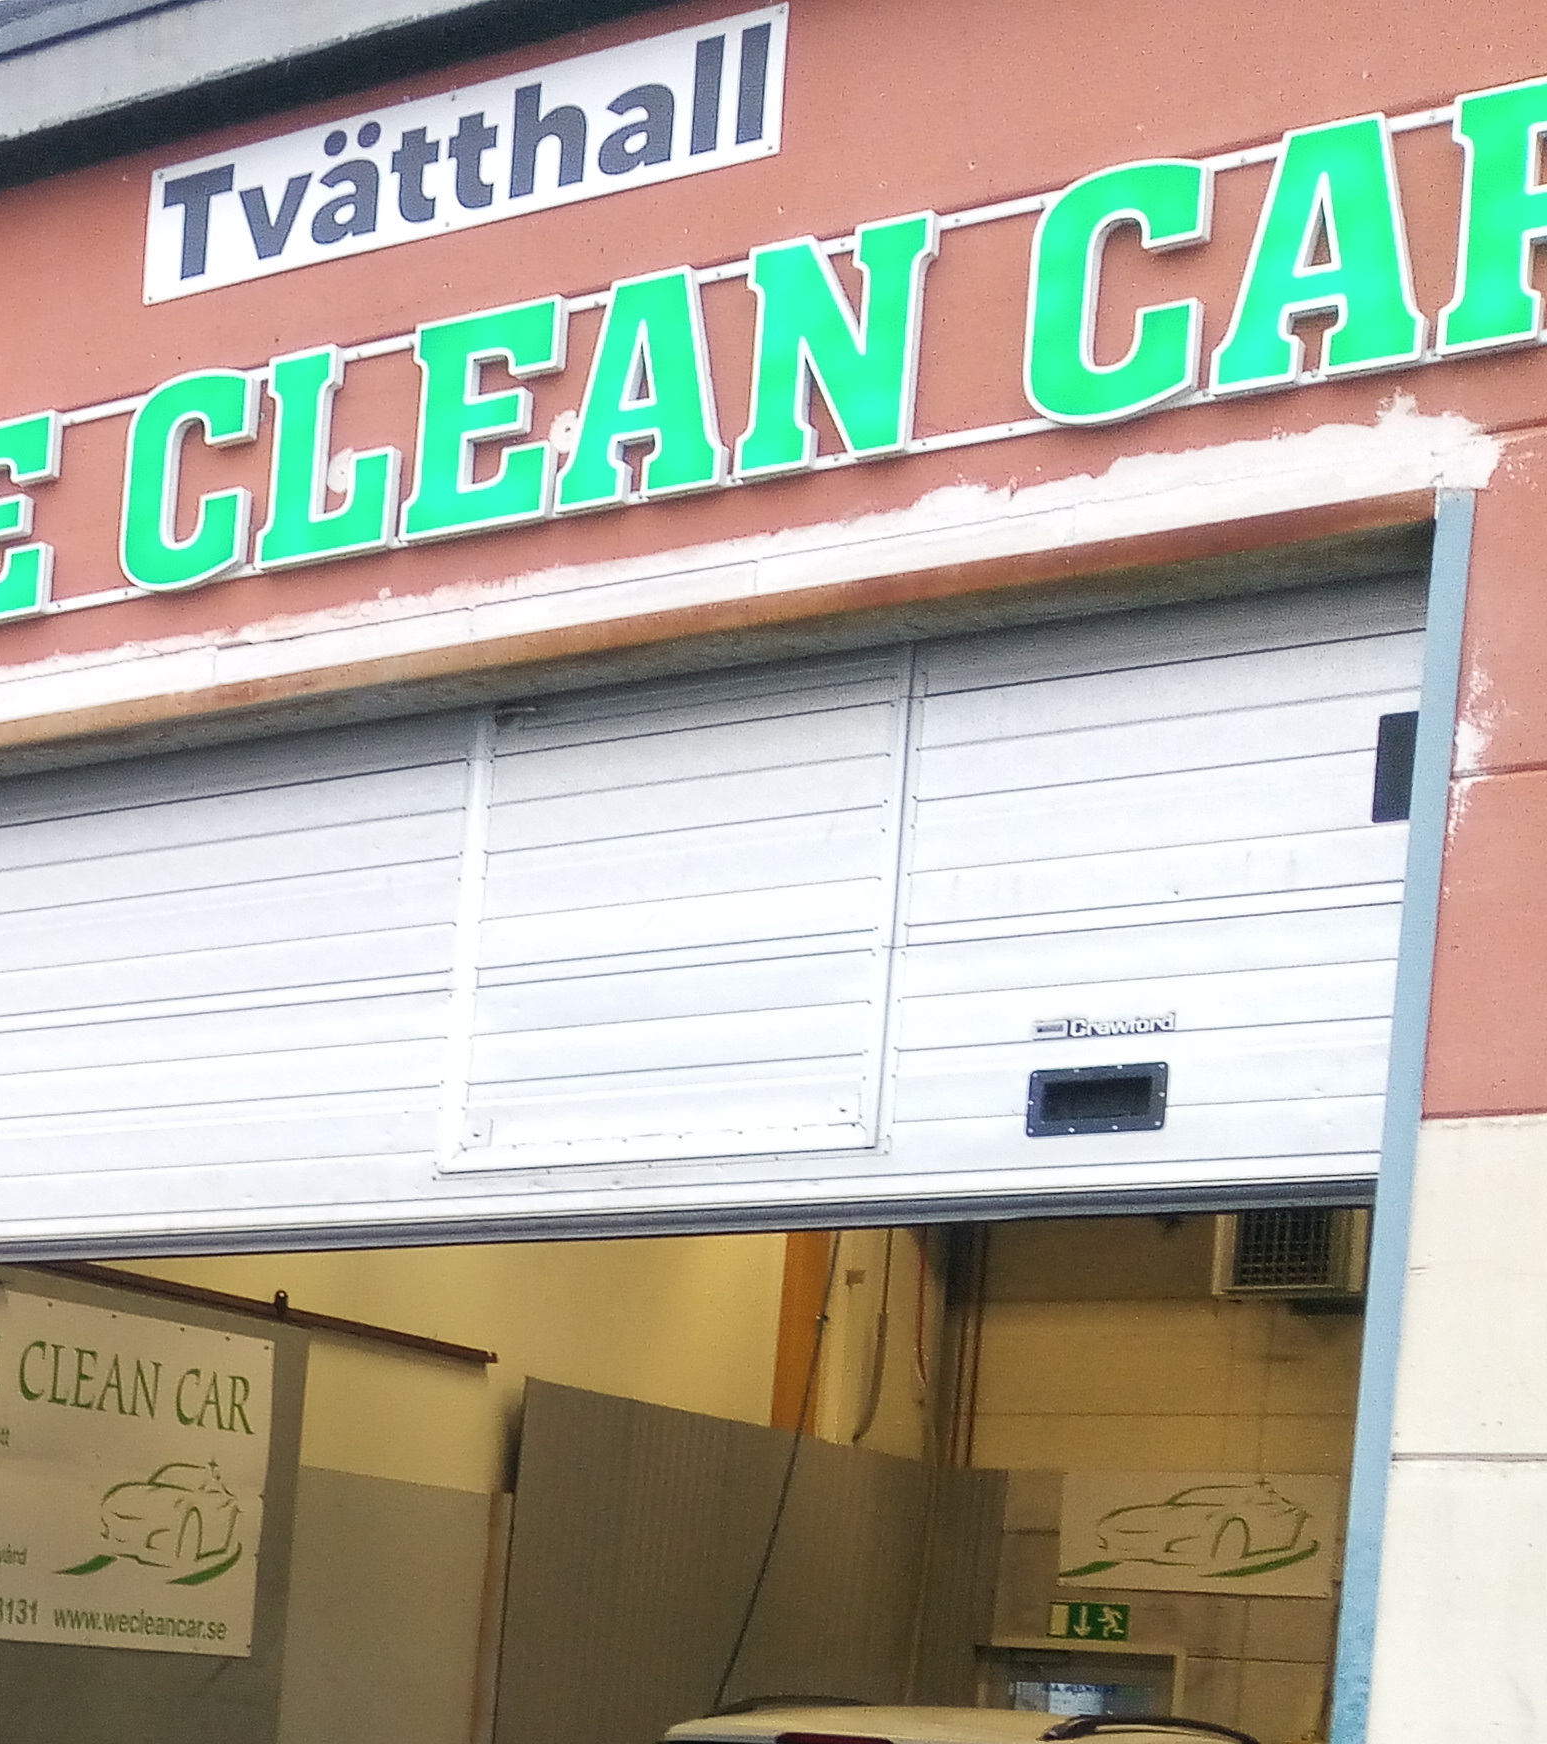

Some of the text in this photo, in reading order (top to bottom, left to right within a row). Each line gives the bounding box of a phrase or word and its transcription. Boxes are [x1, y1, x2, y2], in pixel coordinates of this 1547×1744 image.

[161, 17, 775, 287] Tvätthall
[118, 207, 943, 594] CLEAN
[1071, 1011, 1176, 1037] Crawford
[19, 1339, 163, 1420] CLEAN
[175, 1367, 255, 1435] CAR
[53, 1608, 228, 1641] www.wecleancar.se
